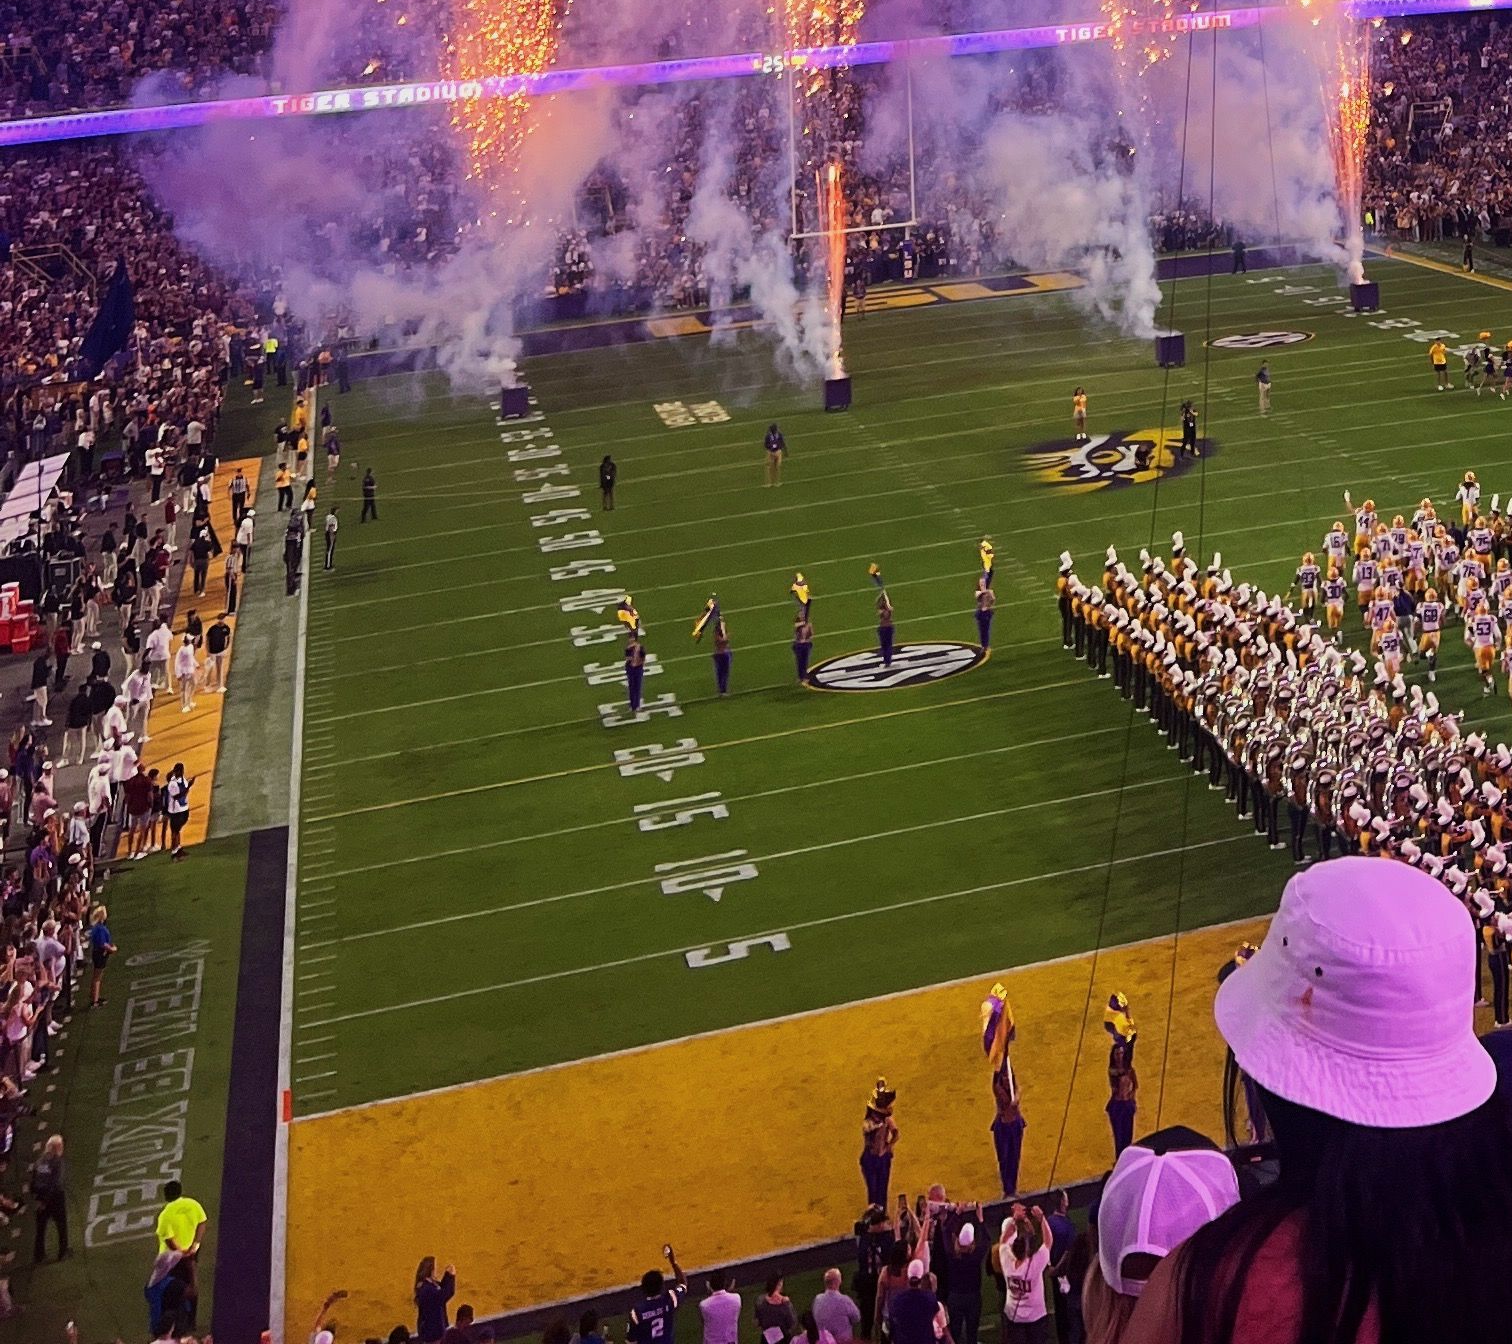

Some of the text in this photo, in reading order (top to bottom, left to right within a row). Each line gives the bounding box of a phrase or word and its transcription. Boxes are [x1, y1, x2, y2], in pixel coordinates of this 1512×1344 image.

[1056, 14, 1232, 43] TIGE STADIUM
[272, 82, 483, 115] TIGER STADIUM
[1358, 515, 1370, 529] 44
[549, 558, 617, 581] 45
[1362, 567, 1373, 580] 13
[1327, 585, 1341, 599] 30
[1376, 607, 1390, 621] 47
[1476, 622, 1491, 636] 53
[613, 734, 705, 777] 20
[633, 791, 730, 832] 15
[654, 848, 759, 895] 10
[685, 932, 792, 969] 5
[651, 1316, 665, 1339] 2
